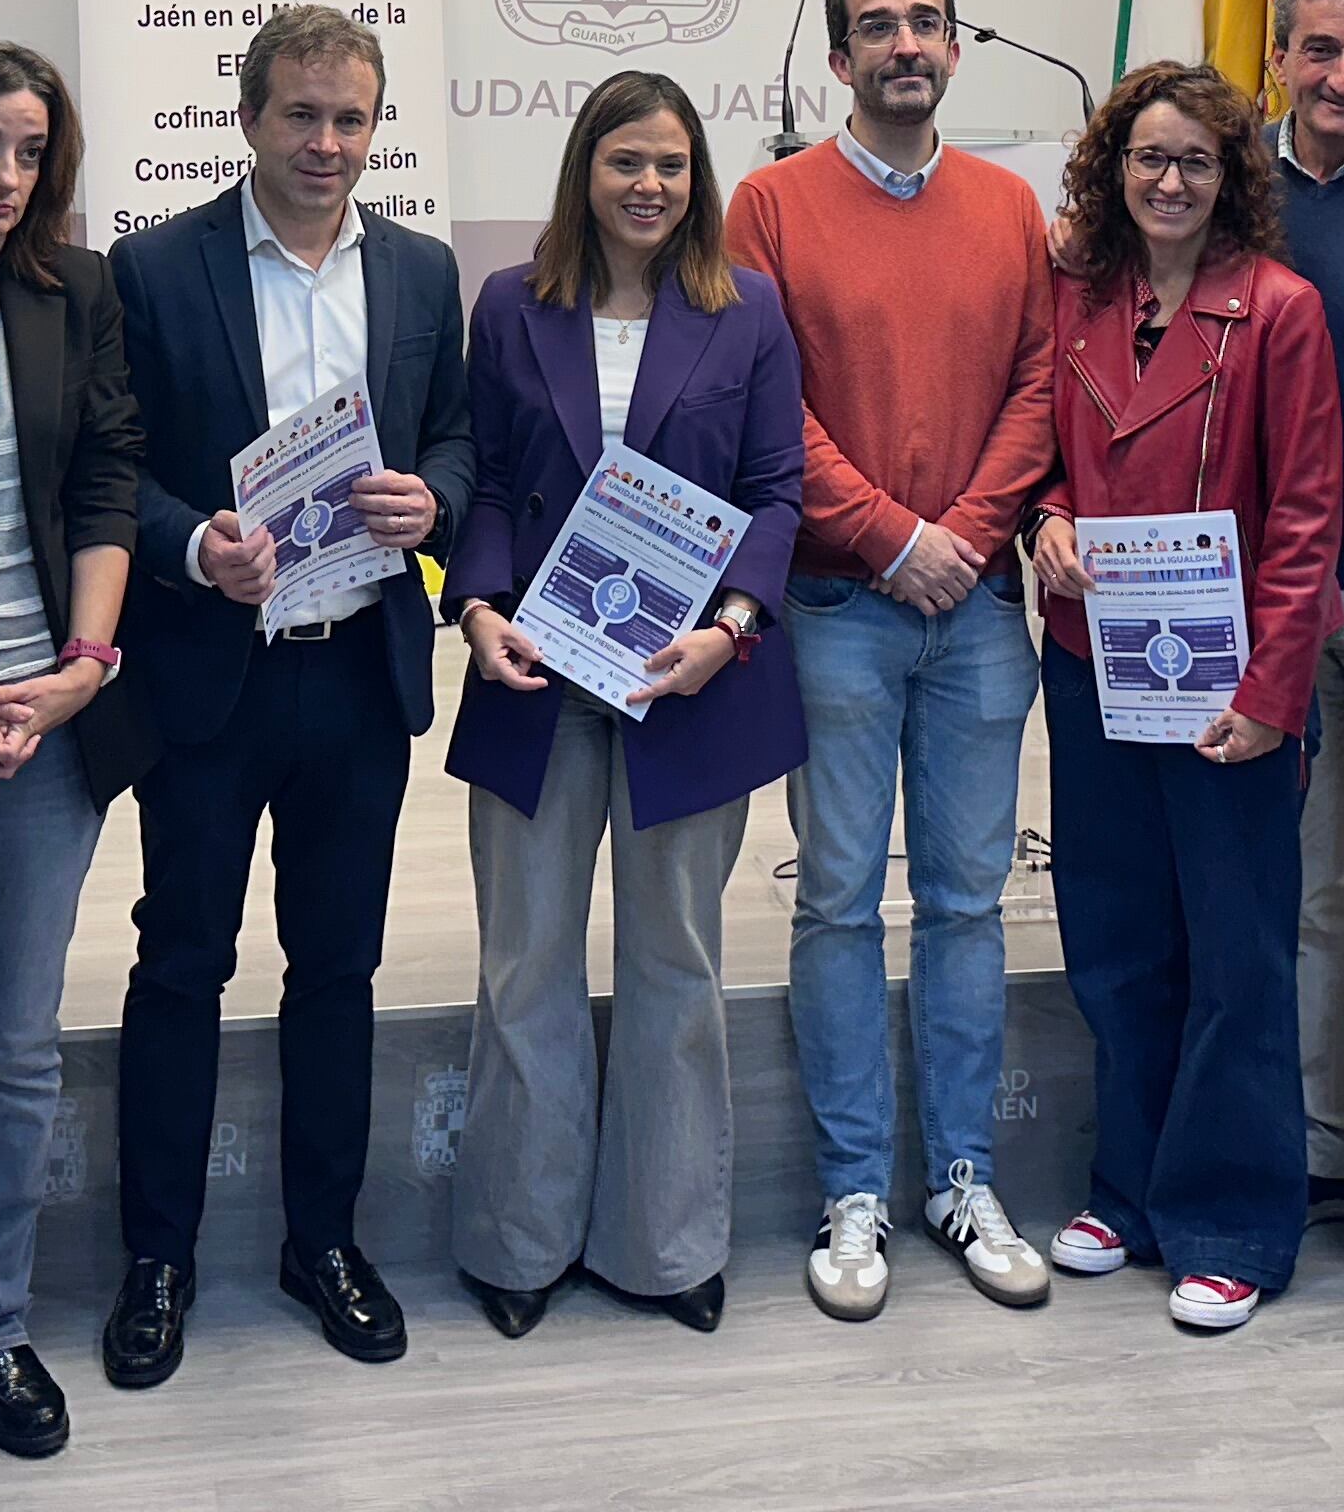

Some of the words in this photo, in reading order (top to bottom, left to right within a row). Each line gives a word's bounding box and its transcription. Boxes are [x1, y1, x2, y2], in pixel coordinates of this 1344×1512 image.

[137, 4, 196, 28] Jaén
[204, 9, 233, 28] en
[242, 4, 262, 27] el
[351, 3, 379, 25] de
[387, 3, 406, 25] la
[570, 27, 626, 45] GUARDA
[701, 74, 827, 124] JAÉN
[135, 153, 255, 184] Consejerí
[424, 198, 435, 215] e
[279, 446, 297, 460] POR
[298, 439, 310, 449] LA
[606, 479, 640, 504] ¡UNIDAS
[641, 499, 659, 514] POR
[660, 509, 670, 521] LA
[671, 515, 717, 547] IGUALDAD!
[1134, 555, 1152, 565] POR
[1154, 555, 1166, 564] LA
[1168, 553, 1217, 564] IGUALDAD!
[584, 631, 594, 640] LO
